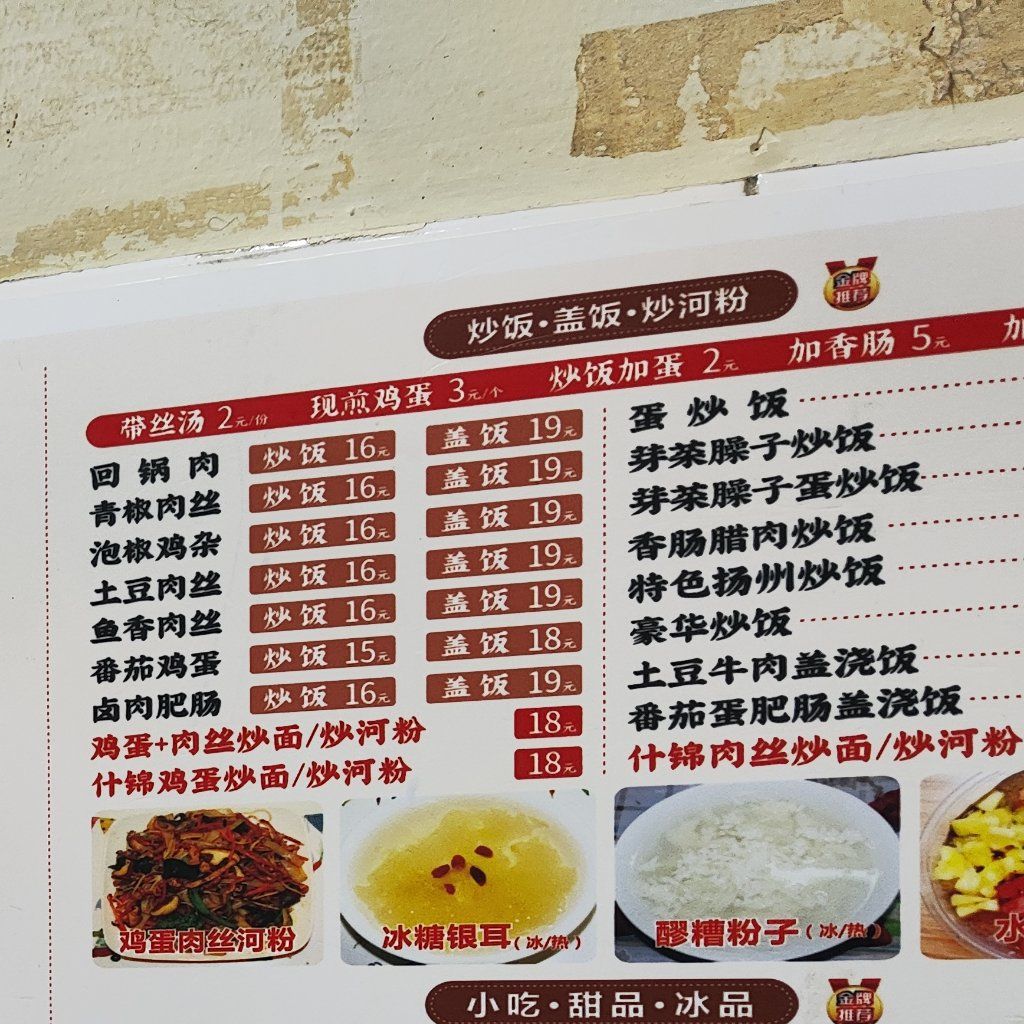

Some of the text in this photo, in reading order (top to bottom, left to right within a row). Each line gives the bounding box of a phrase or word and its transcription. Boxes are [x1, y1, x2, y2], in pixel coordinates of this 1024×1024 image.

[120, 410, 204, 440] 带丝汤
[217, 405, 269, 430] 2元/份
[310, 382, 434, 419] 现煎鸡蛋
[448, 377, 504, 402] 3元/个
[548, 352, 685, 392] 炒饭加蛋
[702, 348, 739, 374] 2元
[787, 328, 895, 365] 加香肠
[912, 324, 951, 351] 5元
[344, 436, 391, 461] 16元
[528, 415, 577, 441] 19元
[627, 422, 877, 473] 芽菜臊子炒饭
[89, 490, 221, 527] 青椒肉丝
[628, 461, 924, 516] 芽菜臊子蛋炒饭
[628, 512, 876, 561] 香肠腊肉炒饭
[90, 570, 223, 606] 土豆肉丝
[627, 554, 886, 604] 特色扬州炒饭
[90, 609, 223, 644] 鱼香肉丝
[629, 606, 793, 646] 豪华炒饭
[627, 643, 920, 690] 土豆牛肉盖浇饭
[92, 689, 222, 724] 卤肉肥肠
[627, 684, 964, 732] 番茄蛋肥肠盖浇饭
[90, 709, 577, 761] 鸡蛋+肉丝炒面/炒河粉 18元
[627, 725, 1024, 773] 什锦肉丝炒面/炒河粉
[91, 756, 413, 798] 什锦鸡蛋炒面/炒河粉
[118, 926, 298, 955] 鸡蛋肉丝河粉
